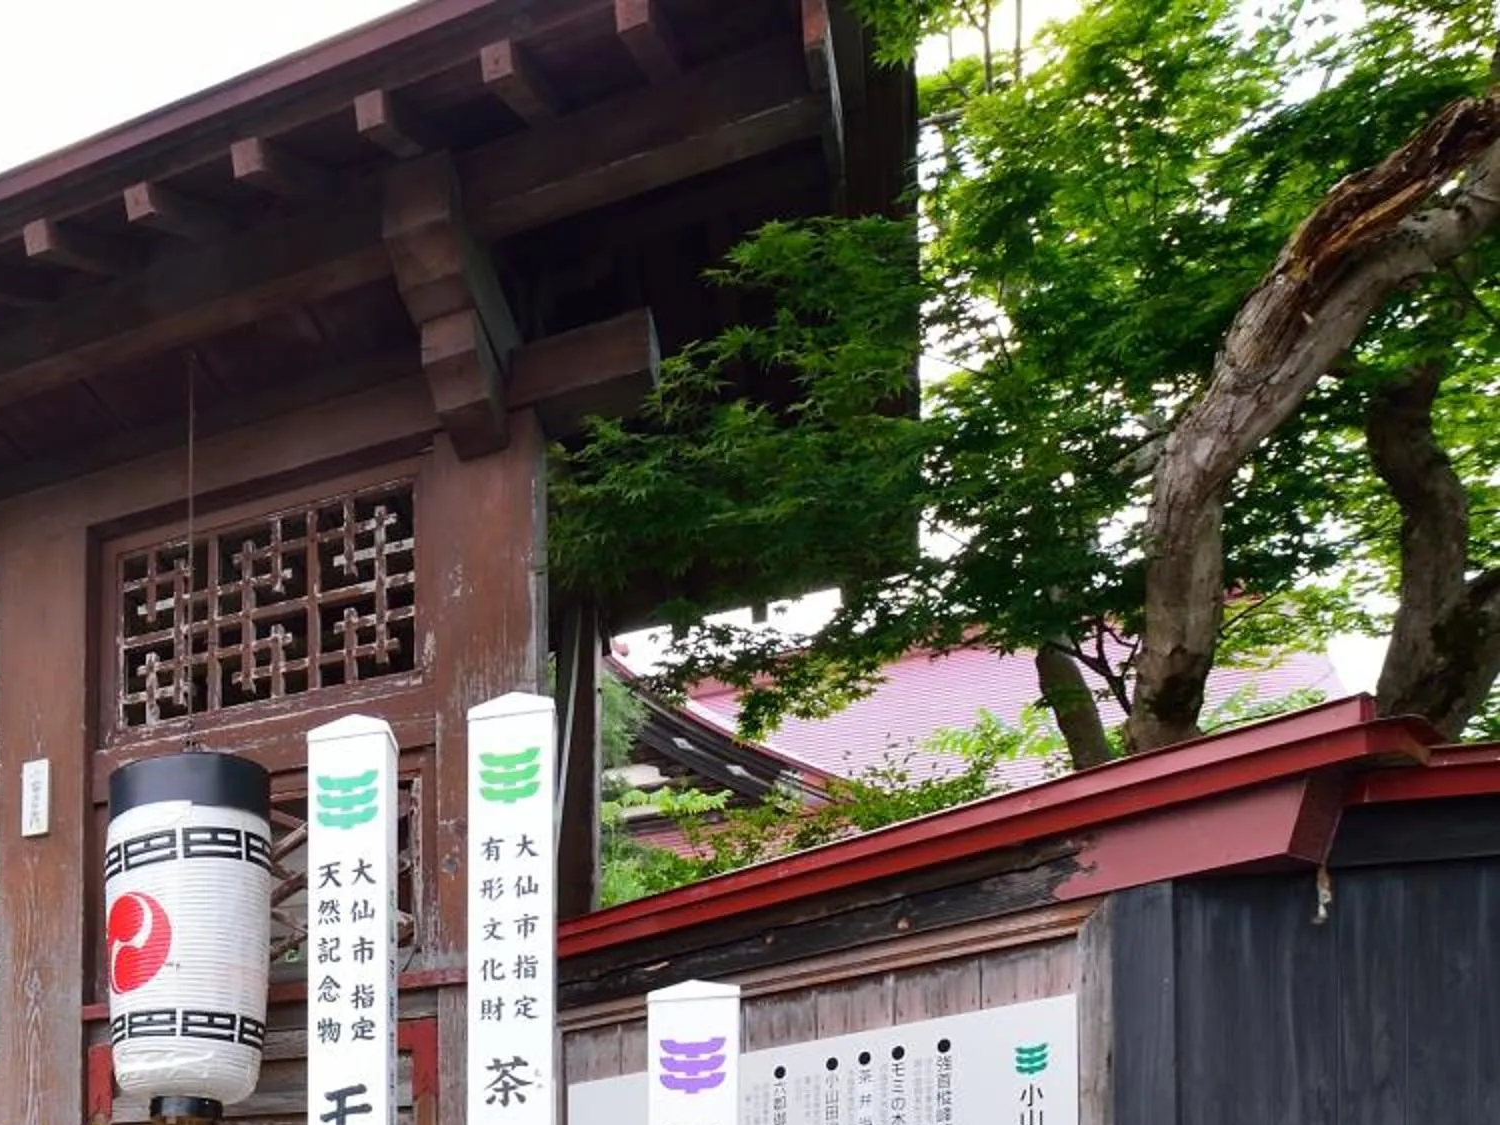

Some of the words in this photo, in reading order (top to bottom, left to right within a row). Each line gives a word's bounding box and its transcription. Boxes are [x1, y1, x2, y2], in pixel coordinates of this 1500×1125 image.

[318, 861, 342, 1045] 天然記念物
[351, 858, 376, 1042] 大仙市指定
[480, 836, 506, 1022] 有形文化財
[512, 833, 539, 1020] 大仙市指定
